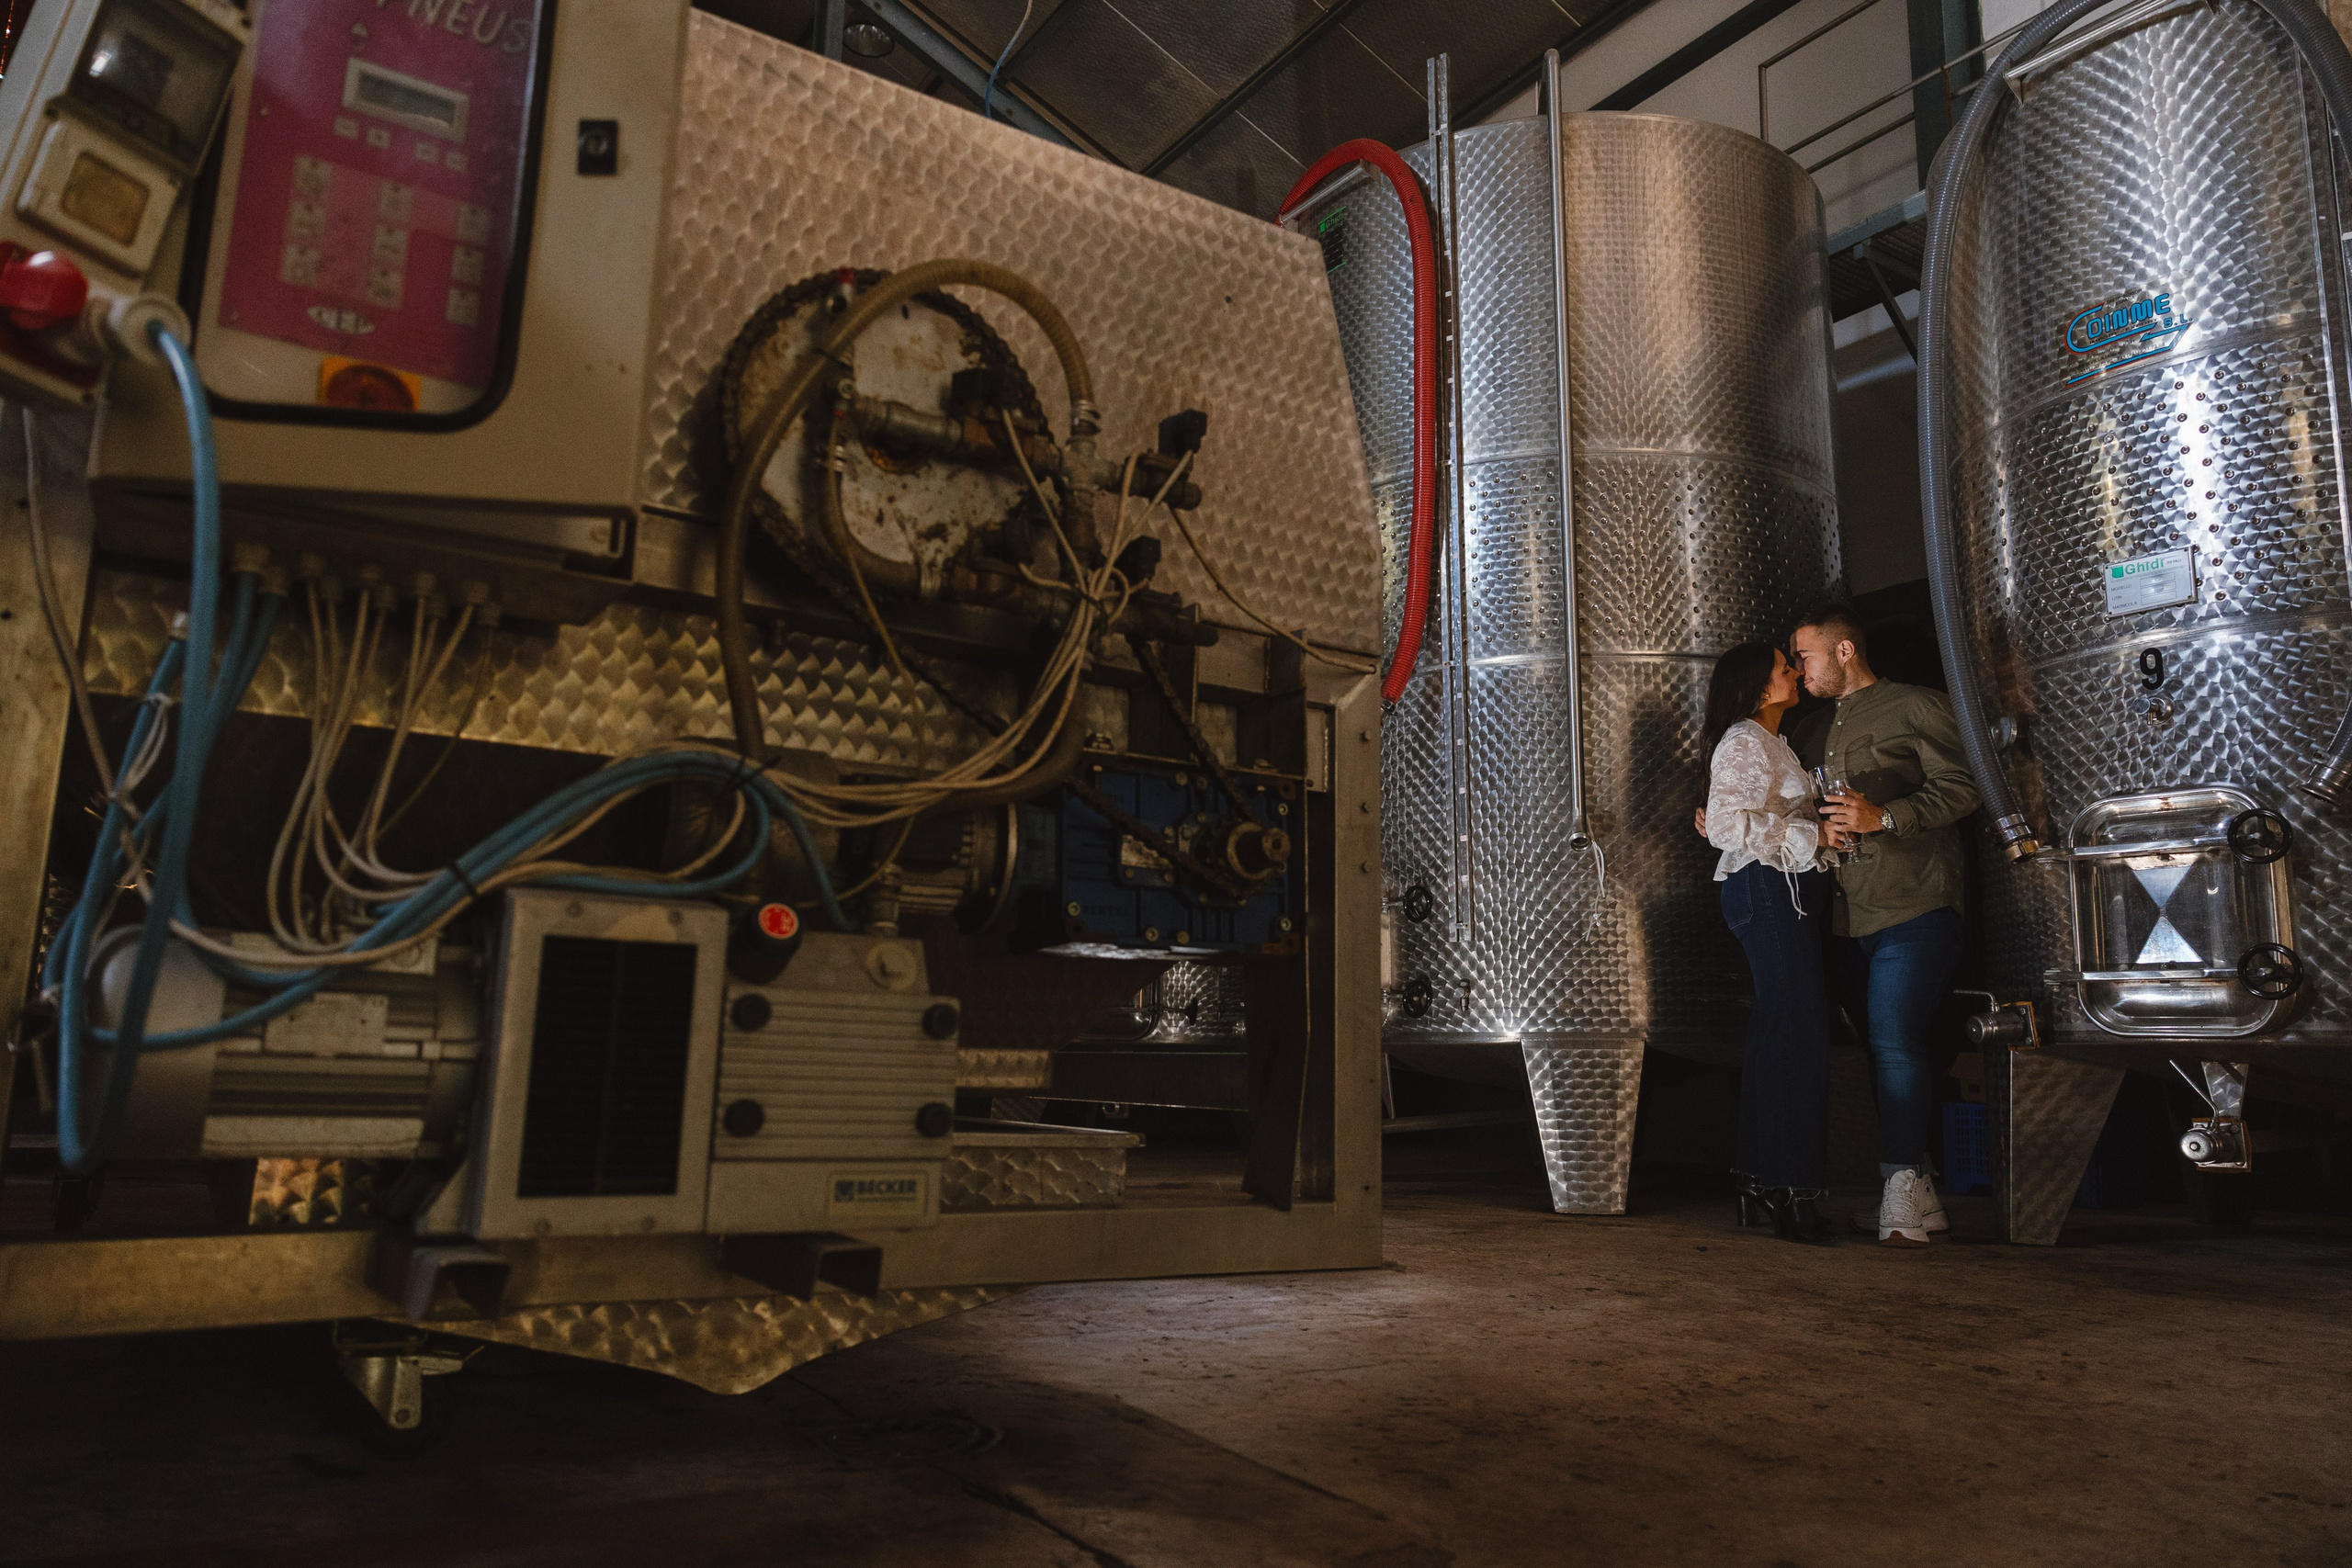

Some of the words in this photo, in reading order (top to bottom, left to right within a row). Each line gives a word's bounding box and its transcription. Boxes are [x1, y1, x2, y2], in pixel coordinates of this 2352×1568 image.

[376, 0, 534, 52] NEUS
[2064, 292, 2171, 355] COINME
[2163, 313, 2193, 328] S.L.
[2124, 557, 2165, 575] Ghidi
[2112, 601, 2138, 609] MATRICOLA
[2140, 648, 2165, 690] 9
[857, 1179, 917, 1194] BECKER
